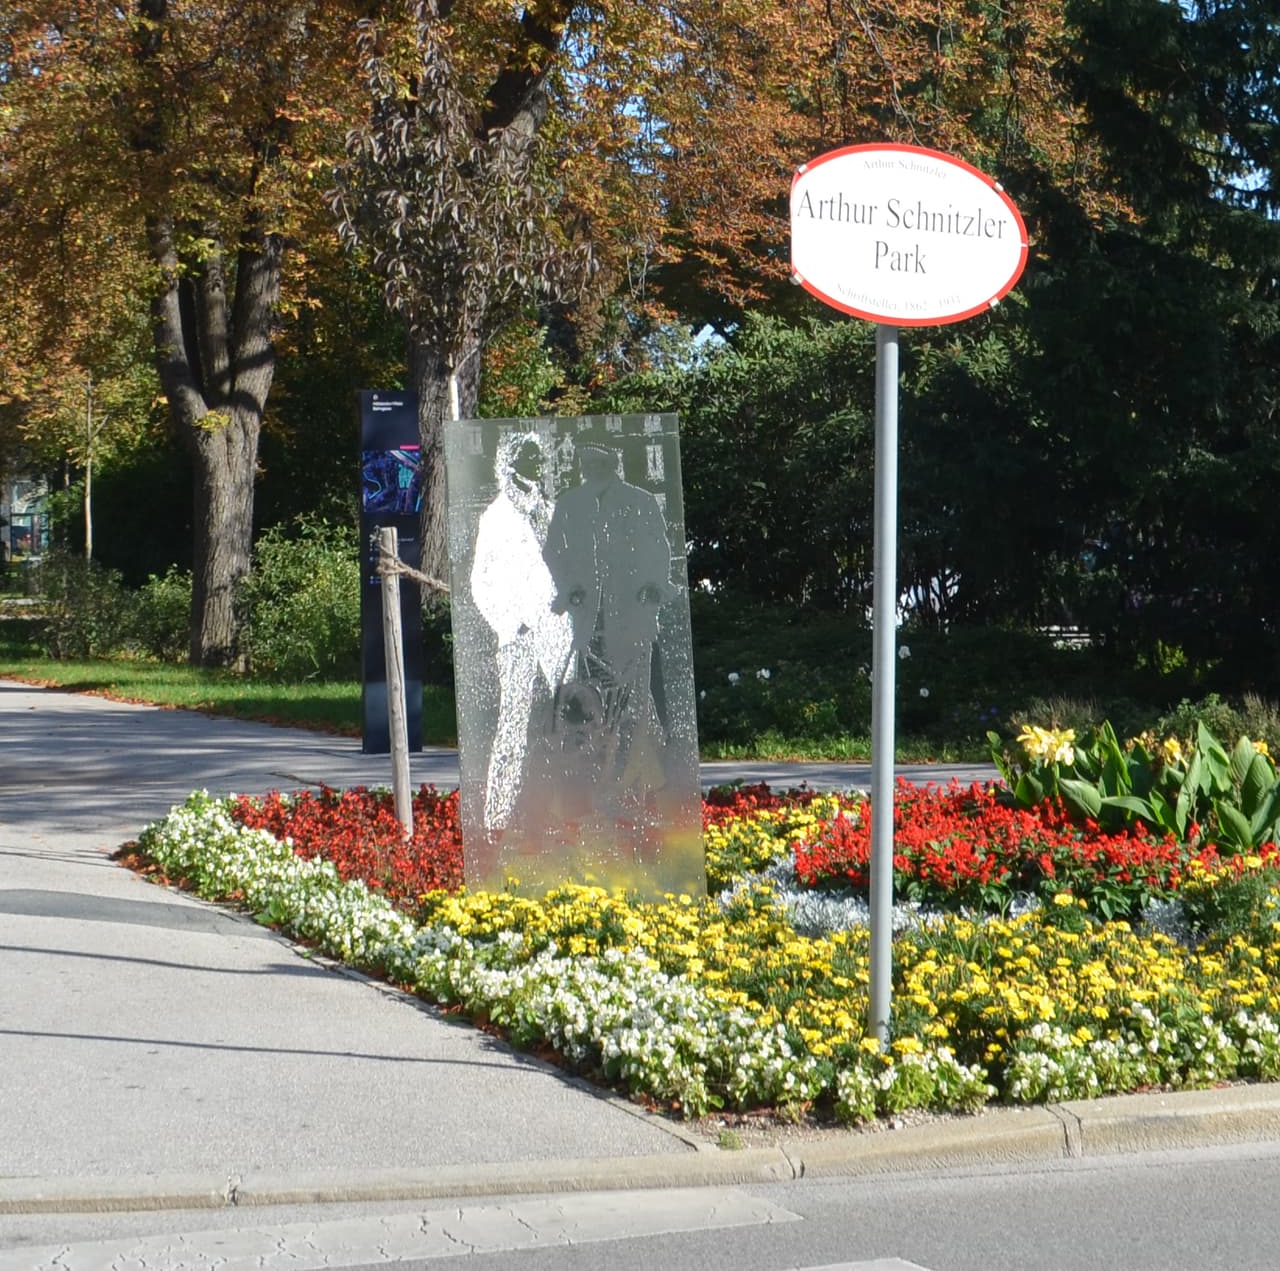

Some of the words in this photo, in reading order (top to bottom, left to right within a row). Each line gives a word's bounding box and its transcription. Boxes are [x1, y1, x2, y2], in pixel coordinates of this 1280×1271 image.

[863, 159, 896, 171] Arthur
[897, 159, 948, 180] Schnitzler
[797, 189, 878, 225] Arthur
[886, 198, 1007, 240] Schnitzler
[874, 240, 927, 274] Park
